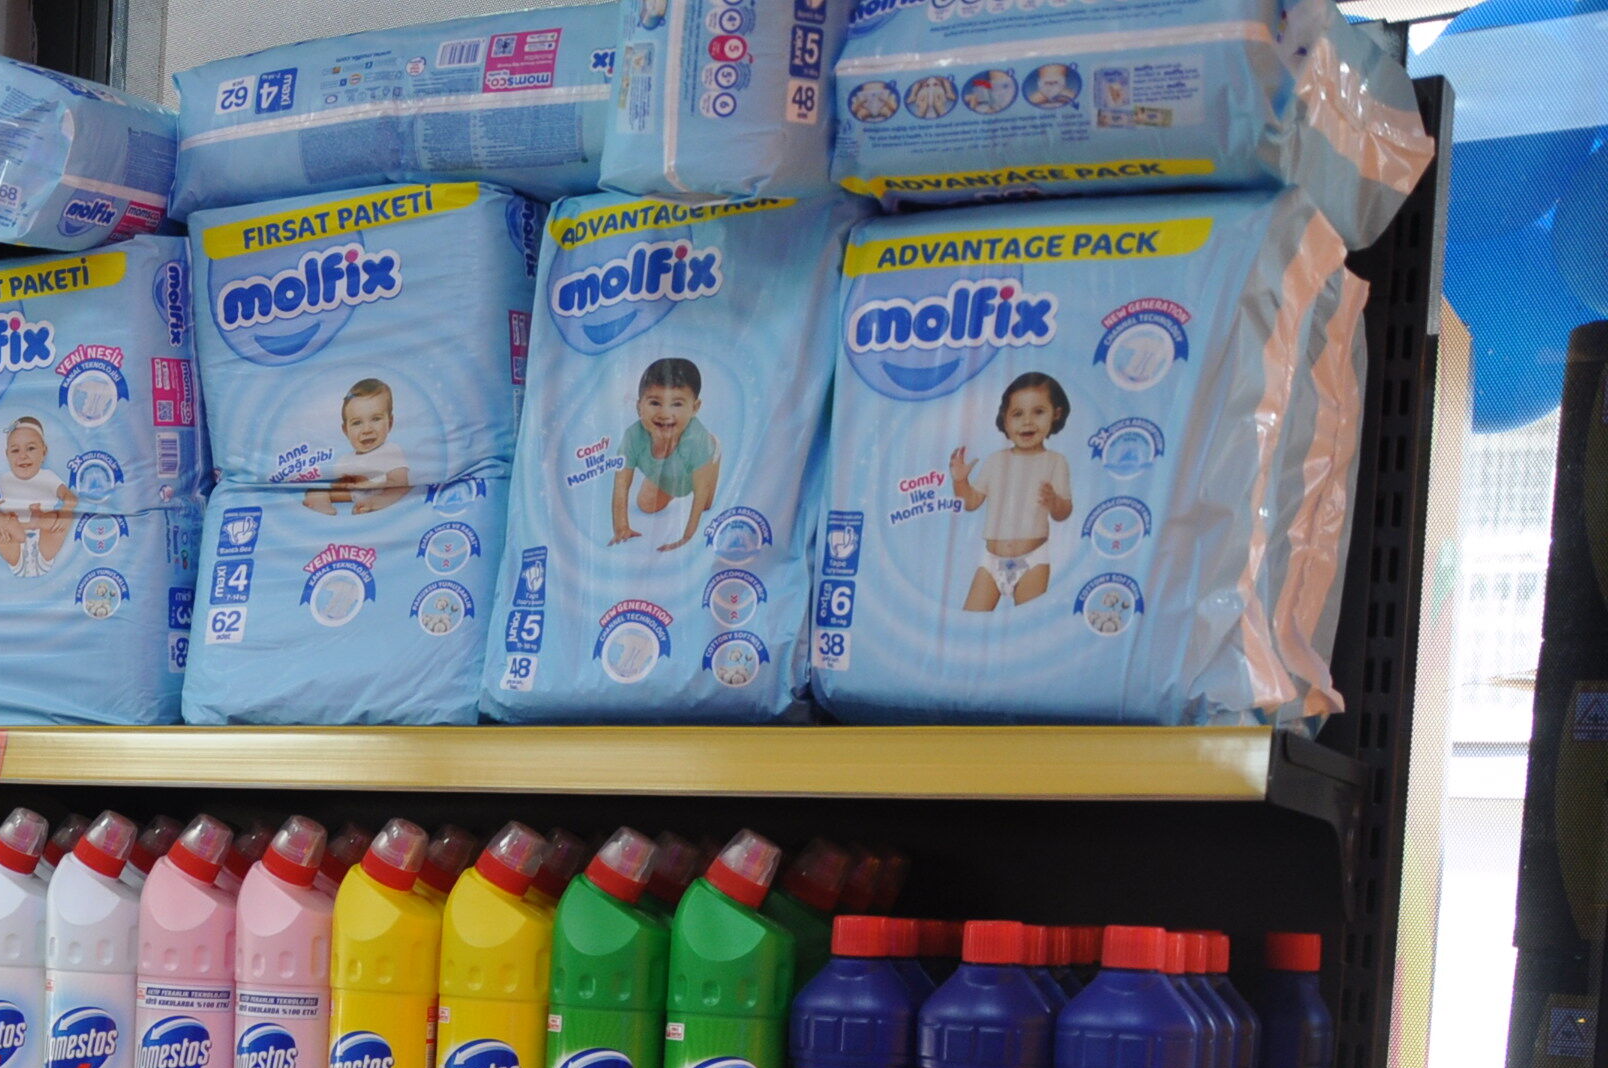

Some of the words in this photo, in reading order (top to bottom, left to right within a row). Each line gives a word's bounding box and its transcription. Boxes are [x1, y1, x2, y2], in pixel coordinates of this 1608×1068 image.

[220, 86, 248, 108] 62
[262, 82, 278, 106] 4
[884, 168, 1069, 191] ADVANTAGE
[1076, 162, 1164, 179] PACK
[242, 207, 331, 249] FIRSAT
[338, 185, 434, 230] PAKETİ
[877, 235, 1062, 268] ADVANTAGE
[1072, 230, 1159, 256] PACK
[23, 256, 90, 298] PAKETİ
[222, 249, 396, 325] molfix
[855, 285, 1051, 346] molfix
[1103, 309, 1127, 328] NEW
[1127, 299, 1189, 324] GENERATION
[277, 443, 309, 466] Anne
[308, 448, 333, 467] gibi
[577, 437, 610, 460] Comfy
[585, 453, 605, 468] like
[567, 465, 604, 486] Mom's
[605, 457, 624, 471] Hug
[899, 471, 945, 493] Comfy
[911, 488, 935, 502] like
[890, 498, 934, 525] Mom's
[936, 495, 962, 513] Hug
[305, 544, 337, 573] YENİ
[338, 545, 377, 569] NESİL
[229, 564, 248, 588] 4
[600, 604, 618, 628] NEW
[617, 600, 672, 625] GENERATION
[832, 588, 851, 616] 6
[212, 610, 240, 633] 62
[521, 616, 541, 642] 5
[819, 632, 844, 657] 38
[509, 657, 530, 678] 48
